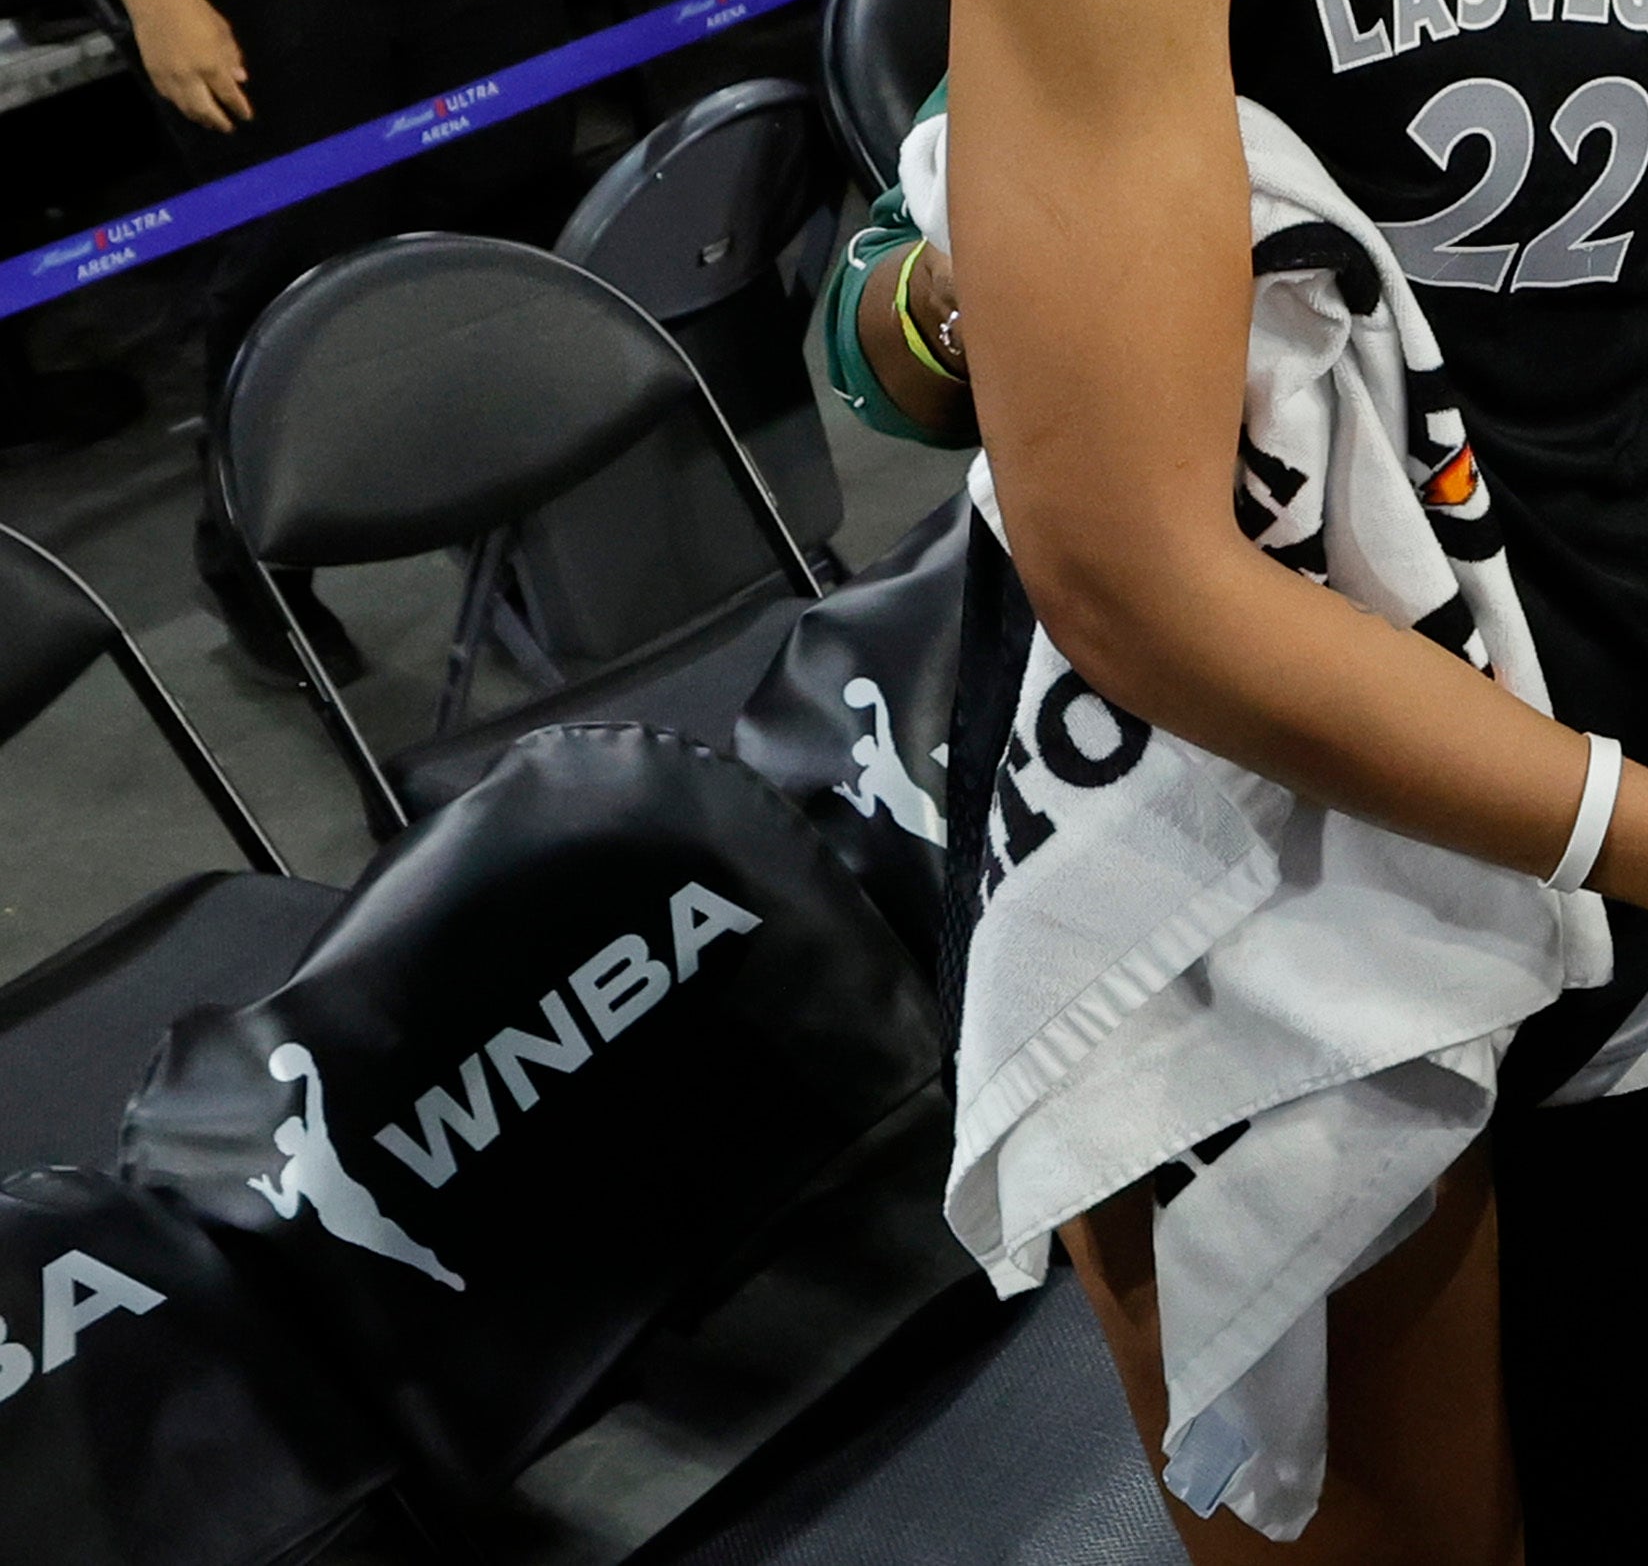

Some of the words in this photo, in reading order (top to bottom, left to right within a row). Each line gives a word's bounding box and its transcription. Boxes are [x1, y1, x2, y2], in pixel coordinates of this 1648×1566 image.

[444, 80, 499, 112] ULTRA
[421, 115, 471, 145] ARENA
[107, 208, 173, 244] ULTRA
[77, 246, 137, 283] ARENA
[373, 880, 764, 1191] WNBA
